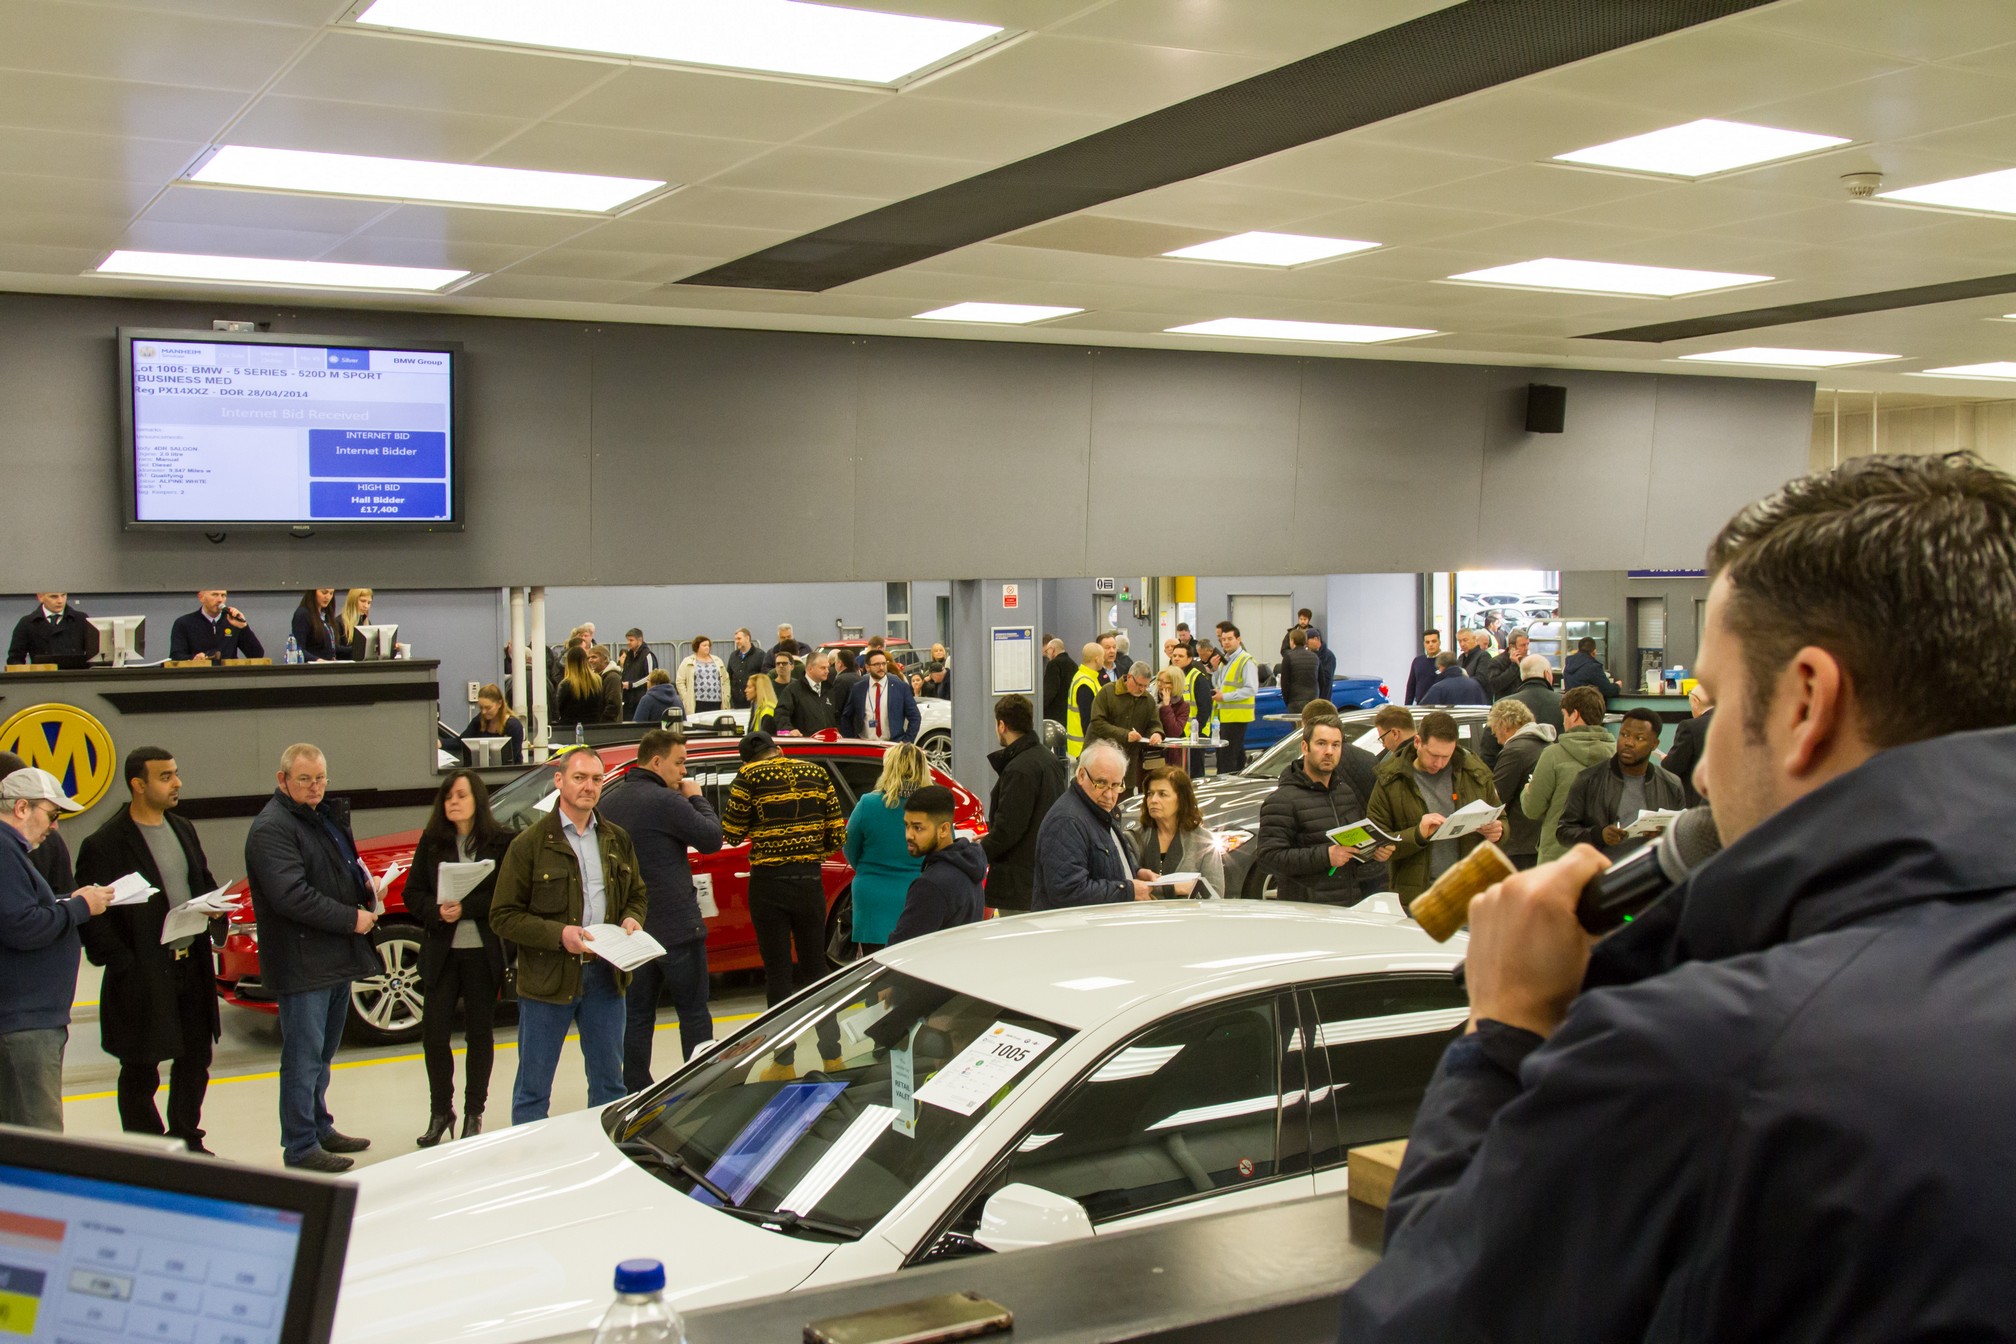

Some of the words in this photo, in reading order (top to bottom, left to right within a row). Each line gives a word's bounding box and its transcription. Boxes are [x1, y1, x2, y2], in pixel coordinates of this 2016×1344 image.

[417, 358, 443, 366] Group
[157, 366, 189, 374] 1005:
[192, 367, 223, 375] BMW
[244, 368, 288, 377] SERIES
[298, 370, 326, 378] 520D
[330, 371, 340, 379] M
[343, 371, 383, 380] SPORT
[205, 376, 232, 385] MED
[158, 387, 209, 395] PX14XXZ
[220, 388, 244, 396] DOR
[247, 389, 309, 399] 28/04/2014
[221, 407, 277, 419] Internet
[282, 408, 304, 419] Bid
[309, 410, 369, 421] Received
[346, 431, 392, 440] INTERNET
[394, 432, 410, 440] BID
[336, 446, 379, 455] Internet
[382, 446, 417, 456] Bidder
[351, 496, 371, 504] Hall
[373, 496, 405, 504] Bidder
[360, 506, 399, 514] £17,400
[990, 1043, 1030, 1062] 1005
[895, 1079, 911, 1092] RETAIL
[895, 1089, 911, 1101] VALET
